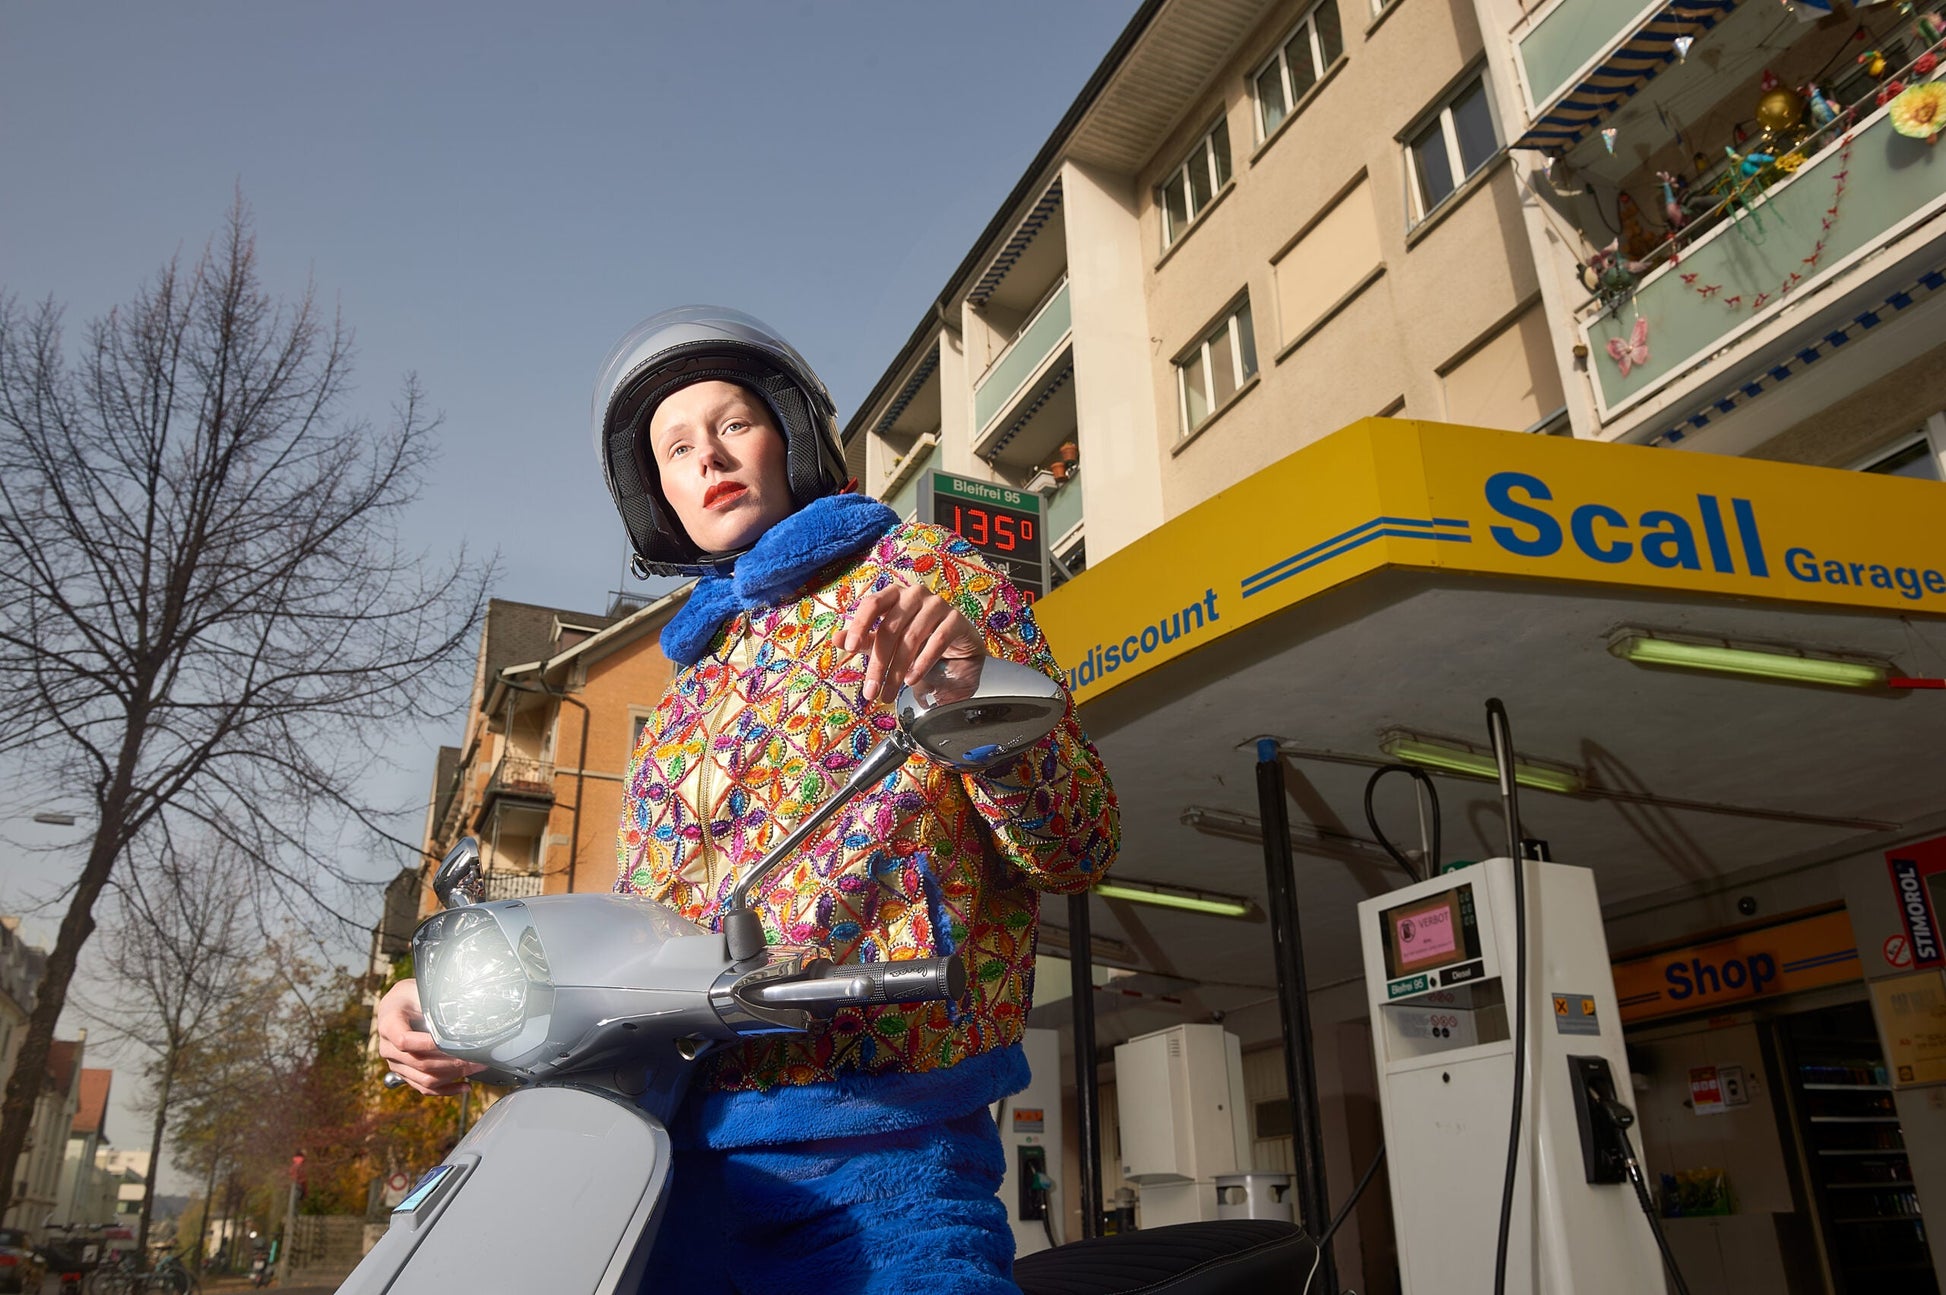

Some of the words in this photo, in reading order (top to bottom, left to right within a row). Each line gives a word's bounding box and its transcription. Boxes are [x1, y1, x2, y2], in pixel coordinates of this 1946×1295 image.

[953, 479, 1000, 500] Bleifrei
[1004, 491, 1021, 504] 95
[1484, 471, 1770, 578] Scall
[1784, 547, 1946, 600] Garage
[1418, 911, 1449, 928] VERBOT
[1899, 867, 1937, 959] STIMOROL
[1665, 952, 1776, 999] Shop
